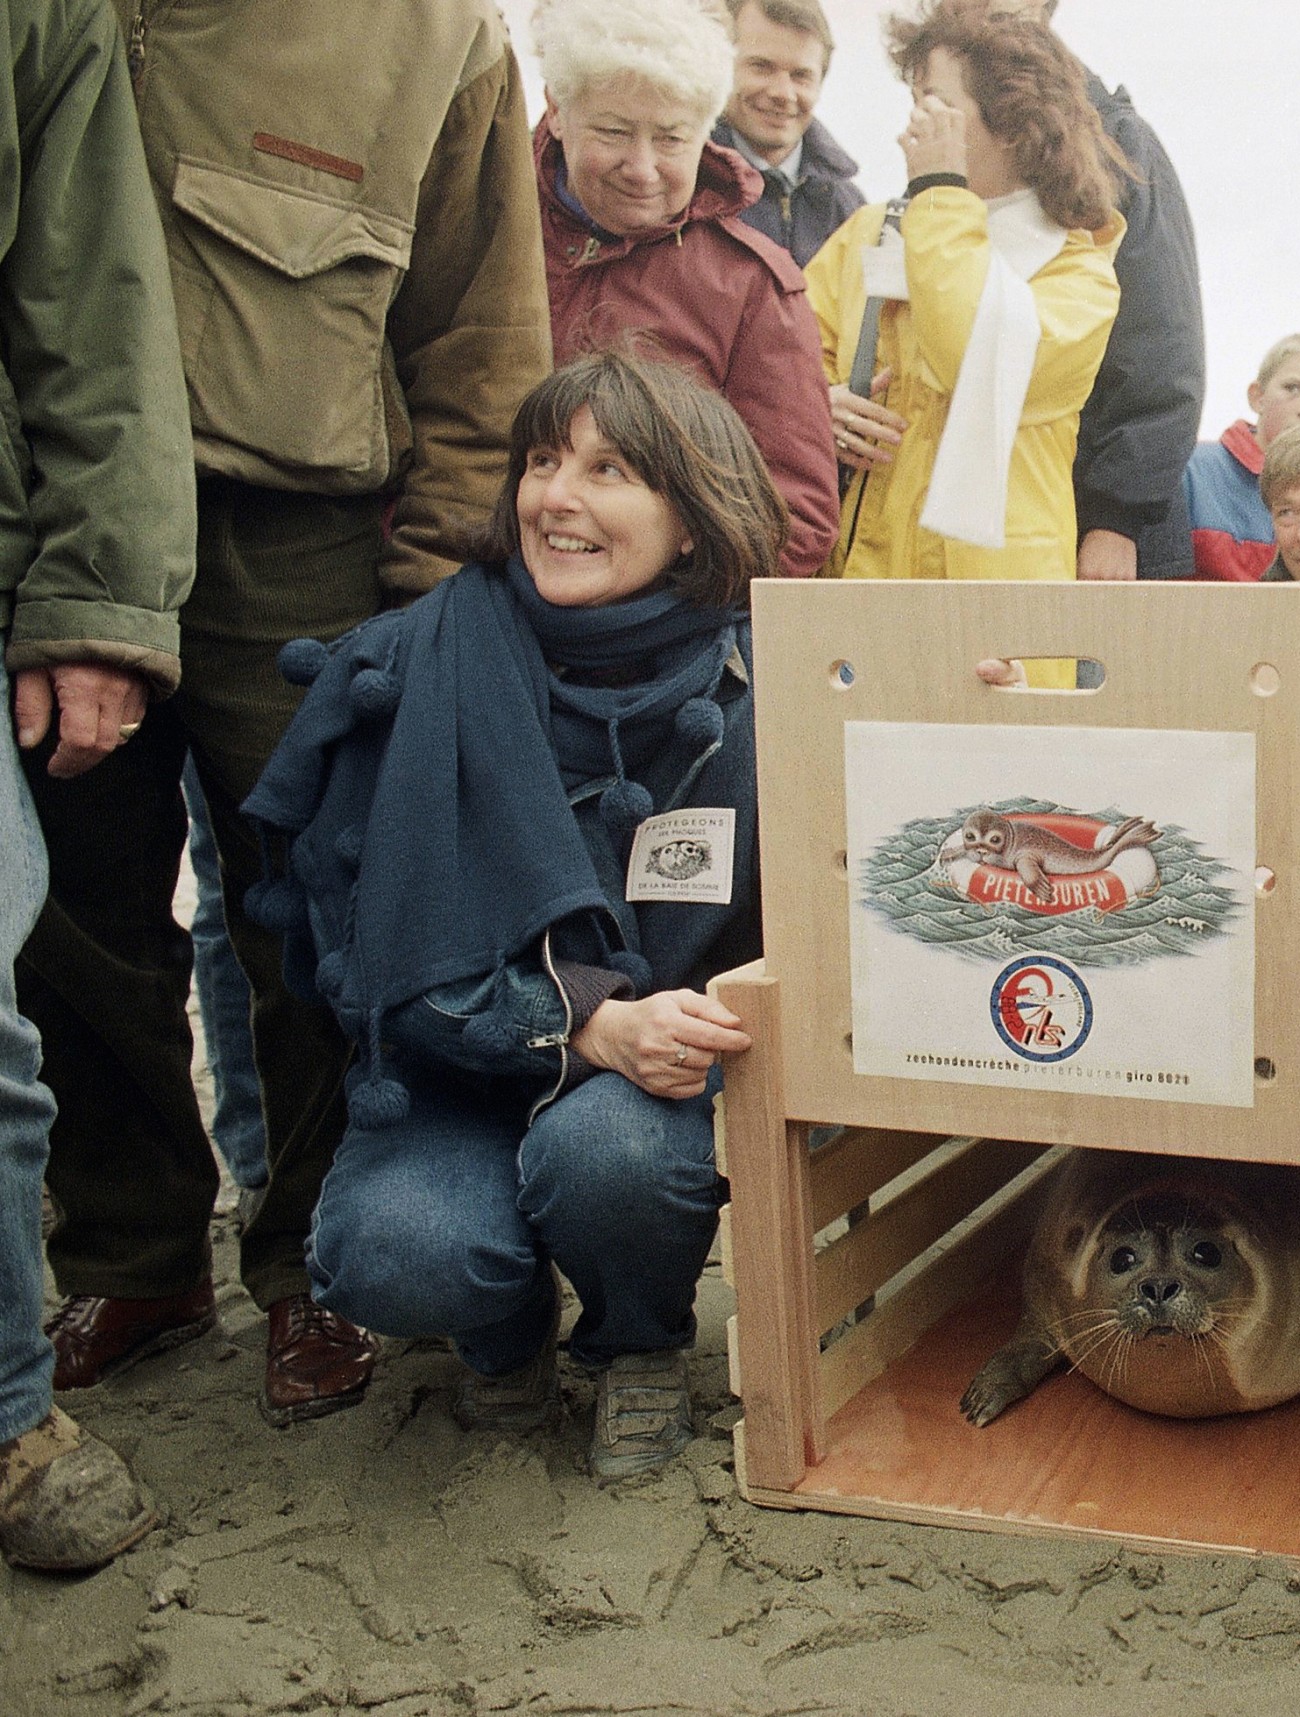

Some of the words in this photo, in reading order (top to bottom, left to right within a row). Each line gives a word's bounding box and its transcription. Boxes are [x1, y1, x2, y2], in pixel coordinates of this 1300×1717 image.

[983, 874, 1111, 906] PIETEBUREN
[906, 1053, 1020, 1072] zeehondencrèche
[1024, 1063, 1121, 1079] pieterburen
[1126, 1070, 1153, 1083] giro
